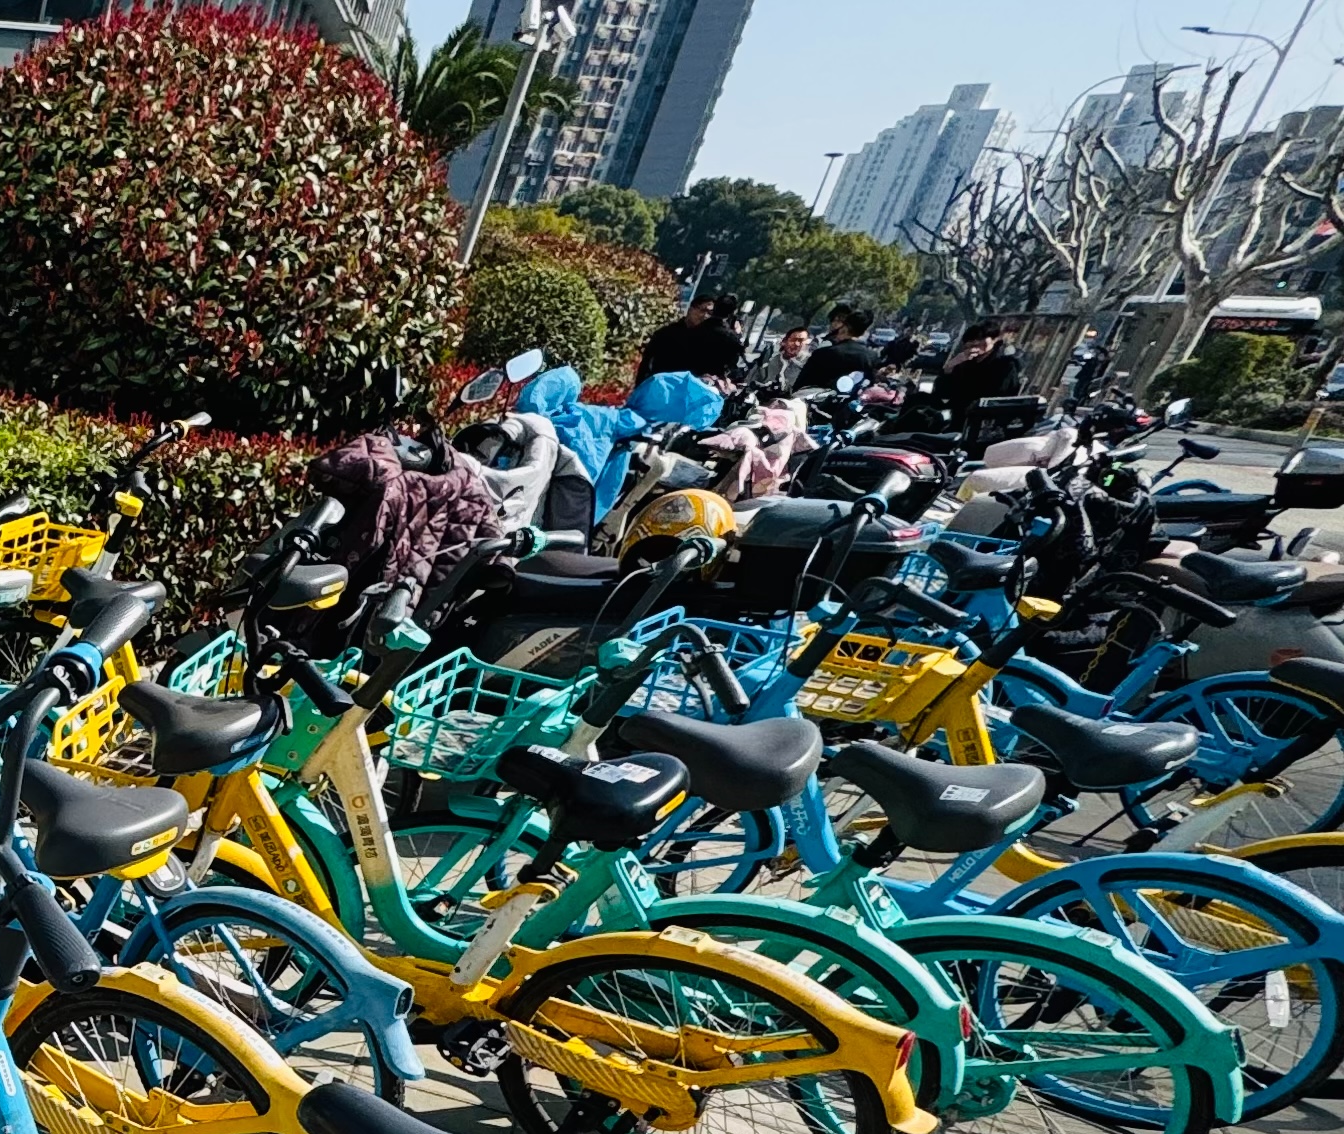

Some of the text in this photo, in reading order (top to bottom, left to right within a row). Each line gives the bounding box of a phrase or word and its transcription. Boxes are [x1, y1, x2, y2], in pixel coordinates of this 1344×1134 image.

[528, 632, 561, 656] YADEA
[356, 813, 378, 859] 滴滴青桔
[947, 856, 977, 884] HELLO
